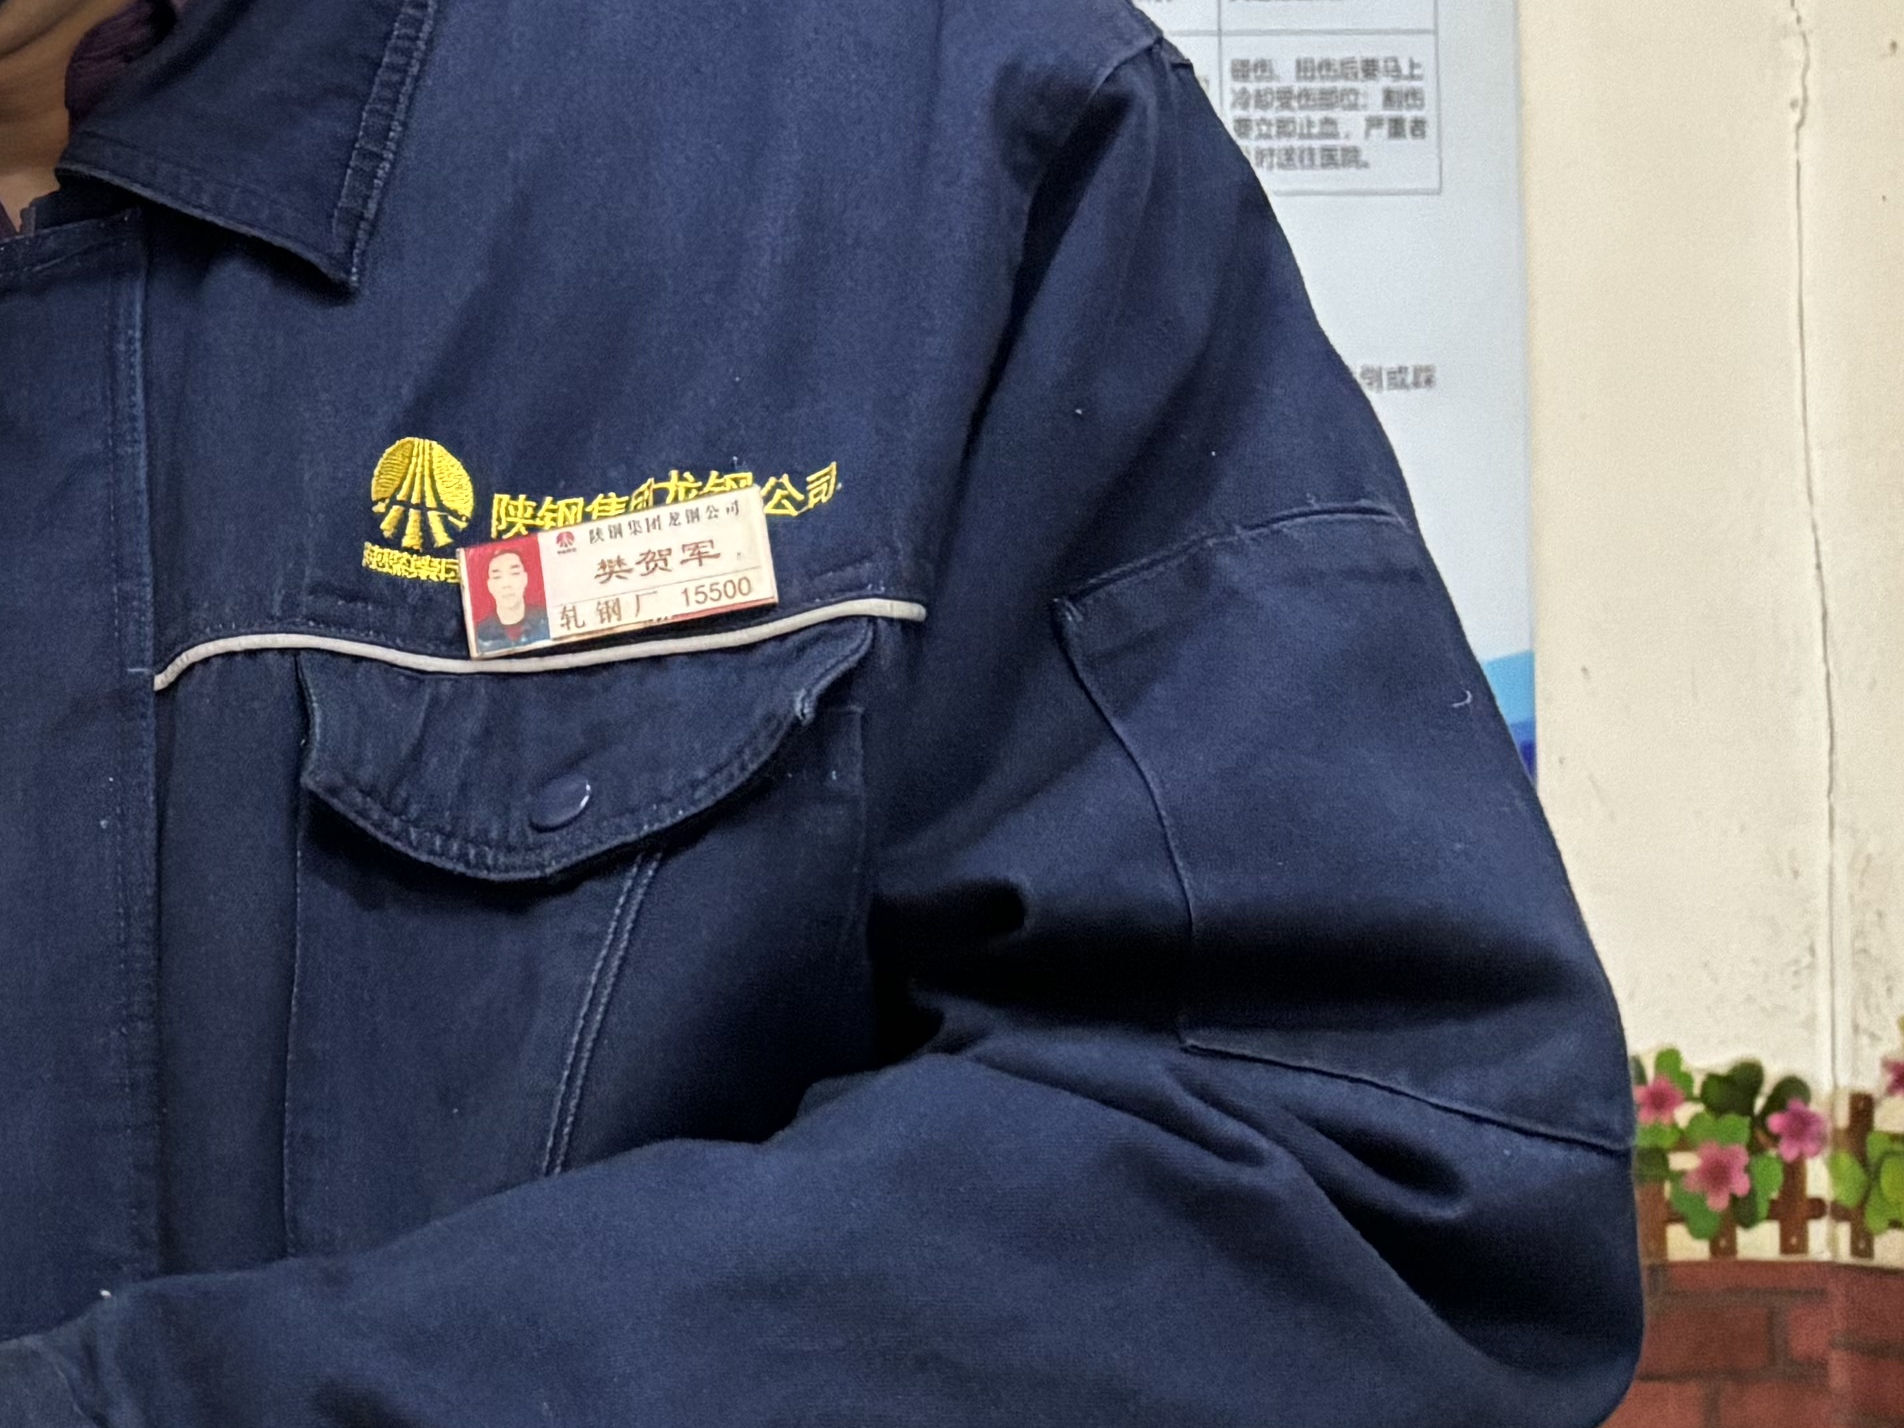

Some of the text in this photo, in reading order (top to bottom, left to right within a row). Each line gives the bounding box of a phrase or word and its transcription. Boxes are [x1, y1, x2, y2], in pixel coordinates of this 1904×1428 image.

[594, 538, 721, 585] 樊贺军
[559, 576, 752, 632] 轧钢厂 15500
